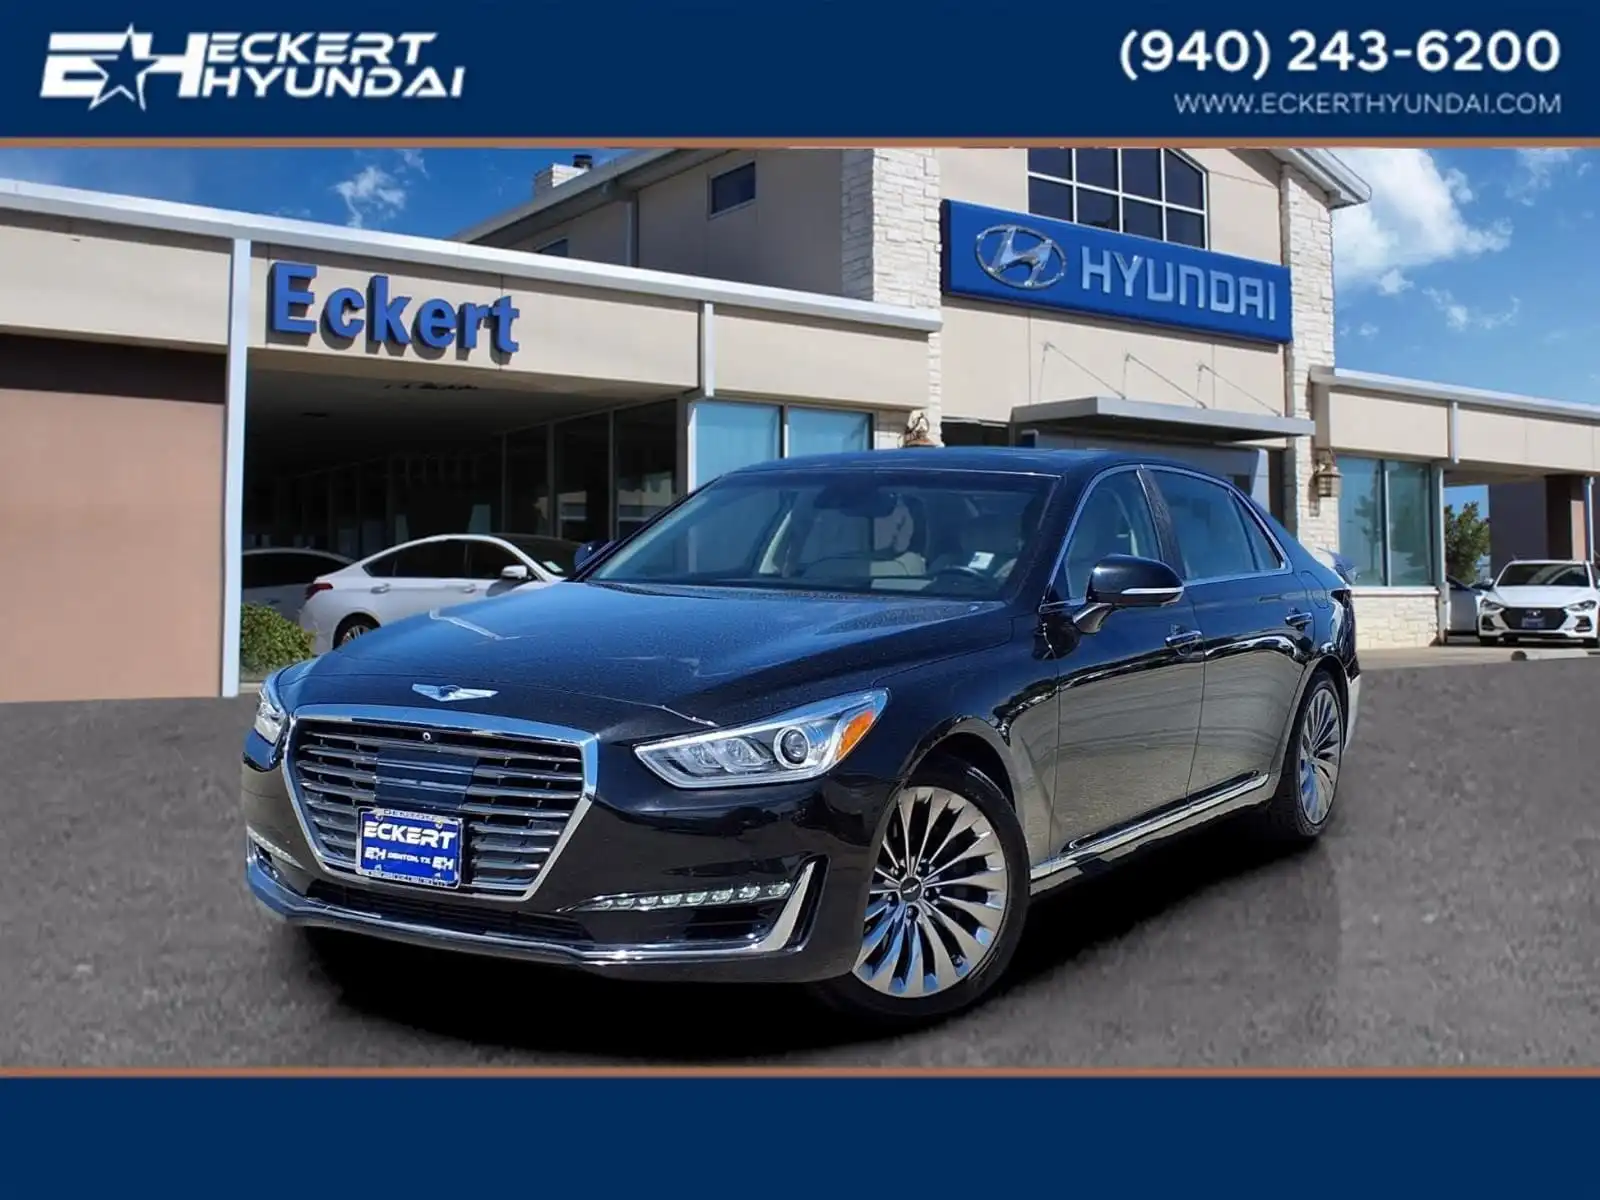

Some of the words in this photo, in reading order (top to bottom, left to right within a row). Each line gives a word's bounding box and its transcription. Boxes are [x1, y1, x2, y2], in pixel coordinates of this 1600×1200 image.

[268, 261, 520, 354] Eckert
[1080, 245, 1277, 321] HYUNDAI
[363, 820, 458, 850] ECKERT
